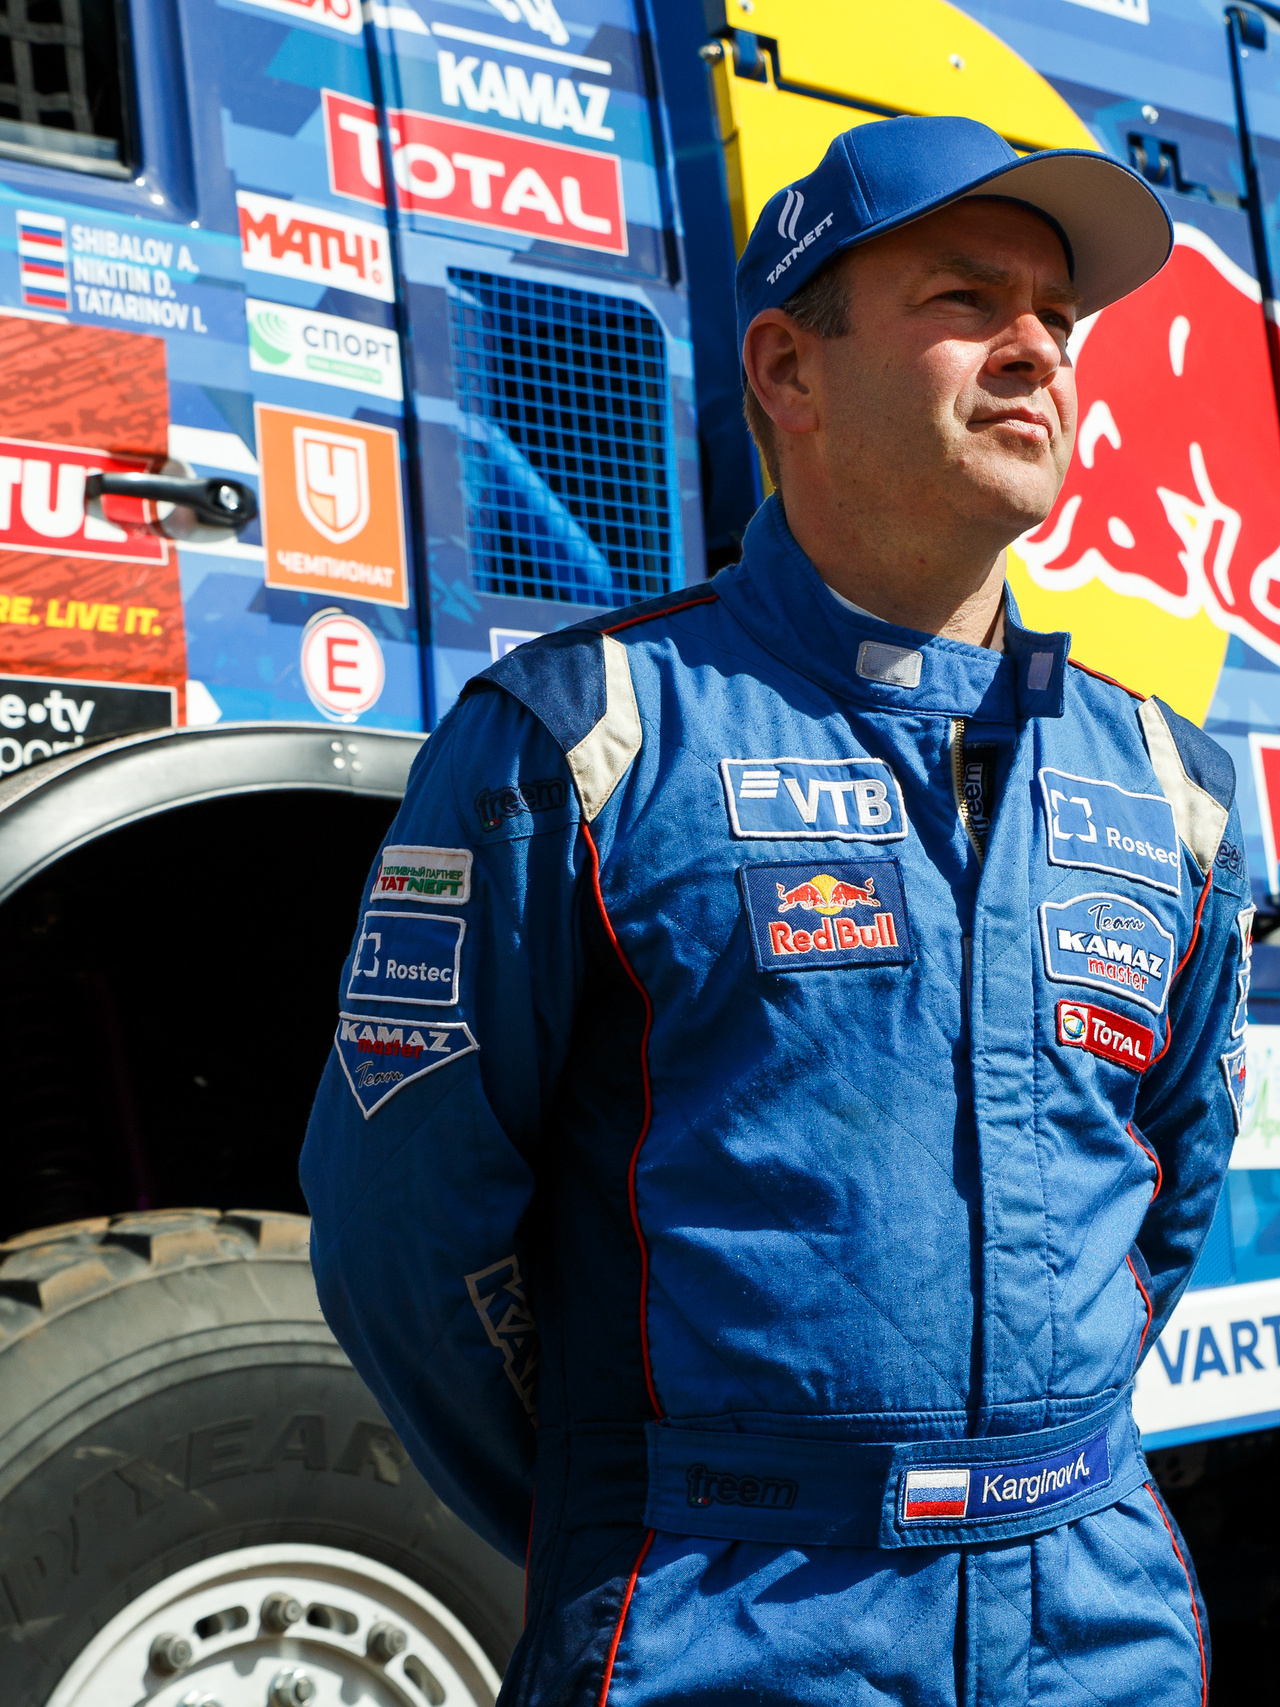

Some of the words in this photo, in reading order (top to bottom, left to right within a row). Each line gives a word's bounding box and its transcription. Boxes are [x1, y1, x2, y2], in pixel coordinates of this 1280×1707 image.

[437, 50, 615, 142] KAMAZ
[338, 113, 612, 235] TOTAL
[71, 224, 173, 268] SHIBALOV
[177, 245, 199, 273] A.
[766, 211, 834, 285] TATNEFT
[73, 255, 151, 294] NIKITIN
[153, 269, 177, 299] D.
[74, 285, 189, 330] TATARINOV
[302, 325, 393, 364] СПОРТ
[277, 549, 395, 588] ЧЕМПИОНАТ
[46, 599, 120, 632] LIVE
[124, 606, 163, 636] IT.
[326, 636, 362, 694] E
[783, 778, 892, 827] VTB
[1106, 827, 1178, 868] Rostec
[381, 877, 463, 896] TATNEFT
[383, 866, 425, 878] ТОПЛИВНЫЙ
[426, 868, 463, 880] ПАРТНЕР
[1089, 903, 1145, 931] Team
[386, 959, 452, 983] Rostec
[1057, 928, 1165, 981] KAMAZ
[1088, 957, 1148, 992] master
[340, 1020, 451, 1053] KAMAZ
[358, 1038, 424, 1059] master
[1091, 1017, 1146, 1061] TOTAL
[355, 1060, 403, 1088] Team
[688, 1464, 798, 1507] freem
[1075, 1451, 1090, 1480] A.
